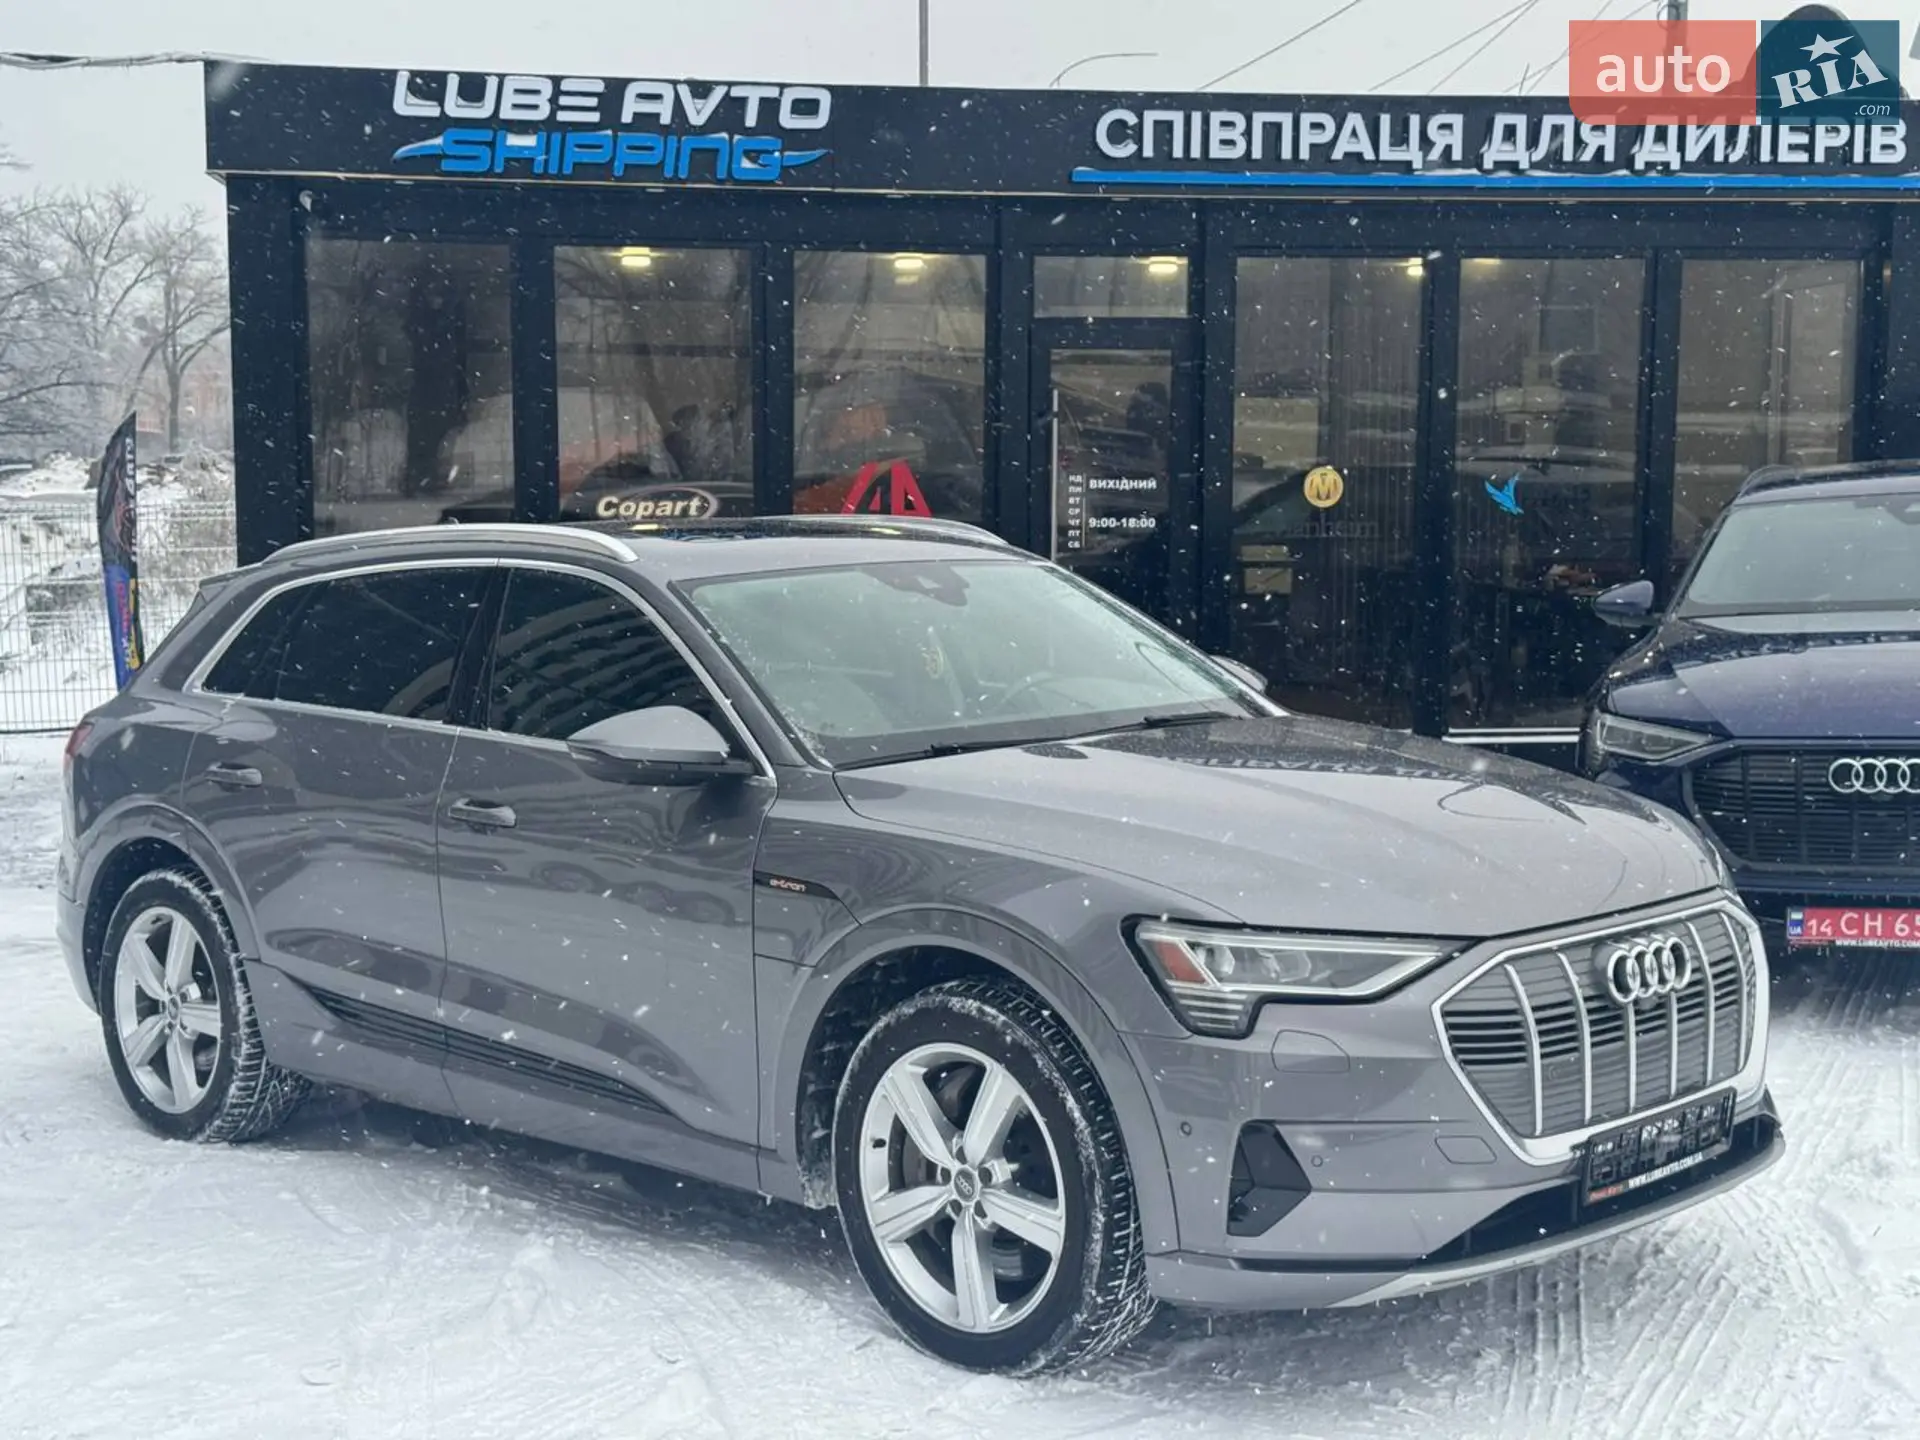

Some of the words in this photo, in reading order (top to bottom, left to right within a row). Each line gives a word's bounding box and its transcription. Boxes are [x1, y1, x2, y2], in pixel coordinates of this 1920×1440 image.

[392, 71, 606, 121] LUBE
[620, 80, 832, 129] AVTO
[1095, 108, 1463, 169] СПІВПРАЦЯ
[1481, 112, 1617, 169] ДЛЯ
[1633, 114, 1908, 170] ДИЛЕРІВ
[1088, 477, 1158, 491] ВИХІДНИЙ
[596, 496, 702, 520] Copart
[1088, 517, 1156, 529] 9:00-18:00
[1807, 918, 1832, 937] 14
